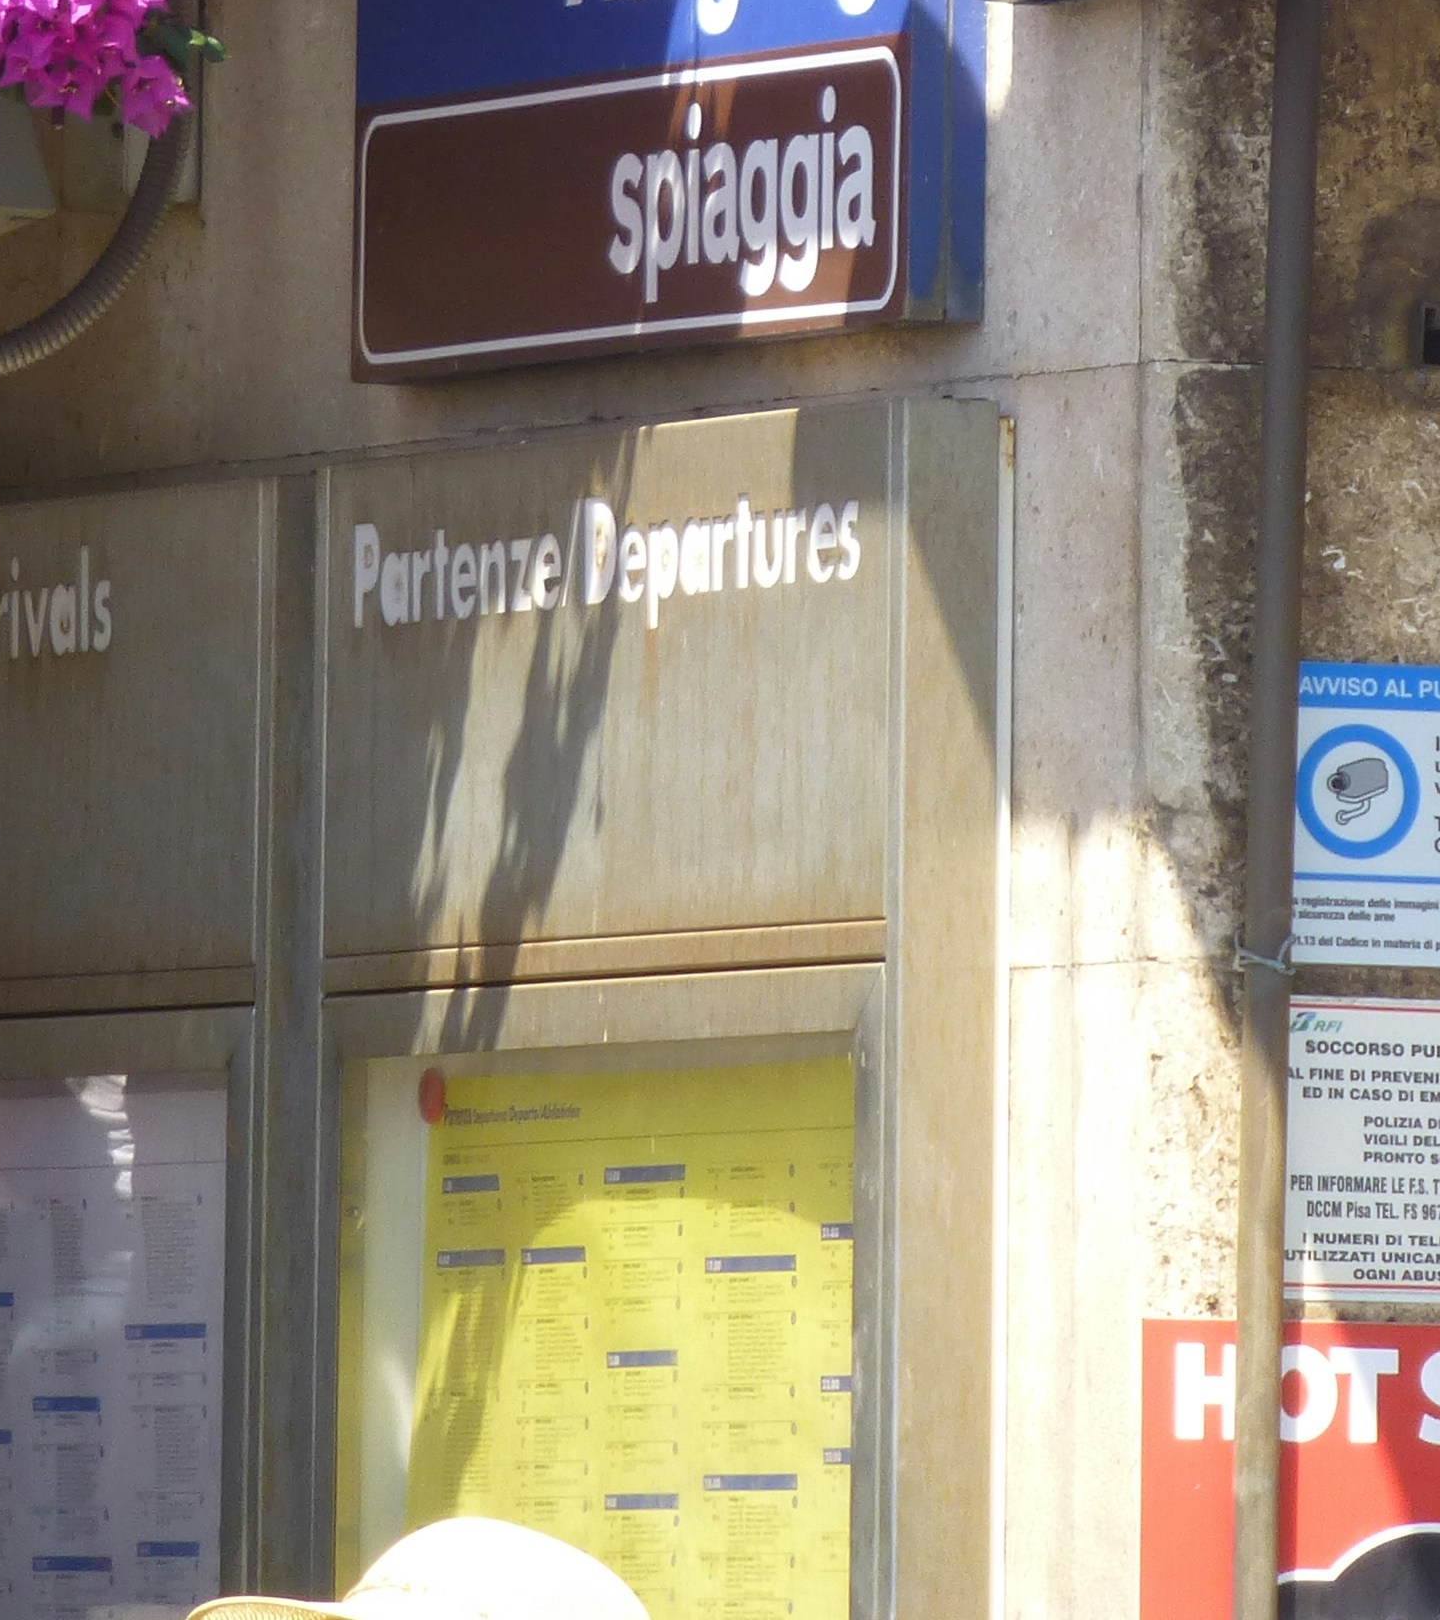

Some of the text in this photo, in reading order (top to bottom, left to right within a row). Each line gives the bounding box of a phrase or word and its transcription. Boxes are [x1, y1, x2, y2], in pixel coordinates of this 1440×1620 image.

[608, 85, 877, 304] spiaggia
[1299, 676, 1378, 697] AVVISO
[1384, 679, 1412, 698] AL
[1313, 1020, 1343, 1032] RFI
[1306, 1040, 1405, 1057] SOCCORSO
[1288, 1068, 1304, 1080] AL
[1309, 1068, 1345, 1081] FINE
[1350, 1069, 1366, 1082] DI
[1302, 1086, 1323, 1099] ED
[1328, 1087, 1344, 1100] IN
[1349, 1088, 1393, 1101] CASO
[1398, 1090, 1414, 1102] DI
[1364, 1116, 1423, 1129] POLIZIA
[1364, 1134, 1408, 1146] VIGILI
[1413, 1135, 1440, 1147] DEL
[1363, 1151, 1425, 1164] PRONTO
[1290, 1174, 1313, 1191] PER
[1317, 1175, 1387, 1193] INFORMARE
[1391, 1177, 1405, 1194] LE
[1409, 1178, 1429, 1195] F.S.
[1307, 1200, 1342, 1218] DCCM
[1346, 1201, 1371, 1218] Pisa
[1375, 1202, 1399, 1219] TEL.
[1404, 1203, 1418, 1220] FS
[1302, 1232, 1307, 1244] I
[1313, 1233, 1379, 1245] NUMERI
[1385, 1235, 1402, 1246] DI
[1284, 1250, 1375, 1263] UTILIZZATI
[1353, 1269, 1396, 1281] OGNI
[1174, 1342, 1399, 1444] HOT
